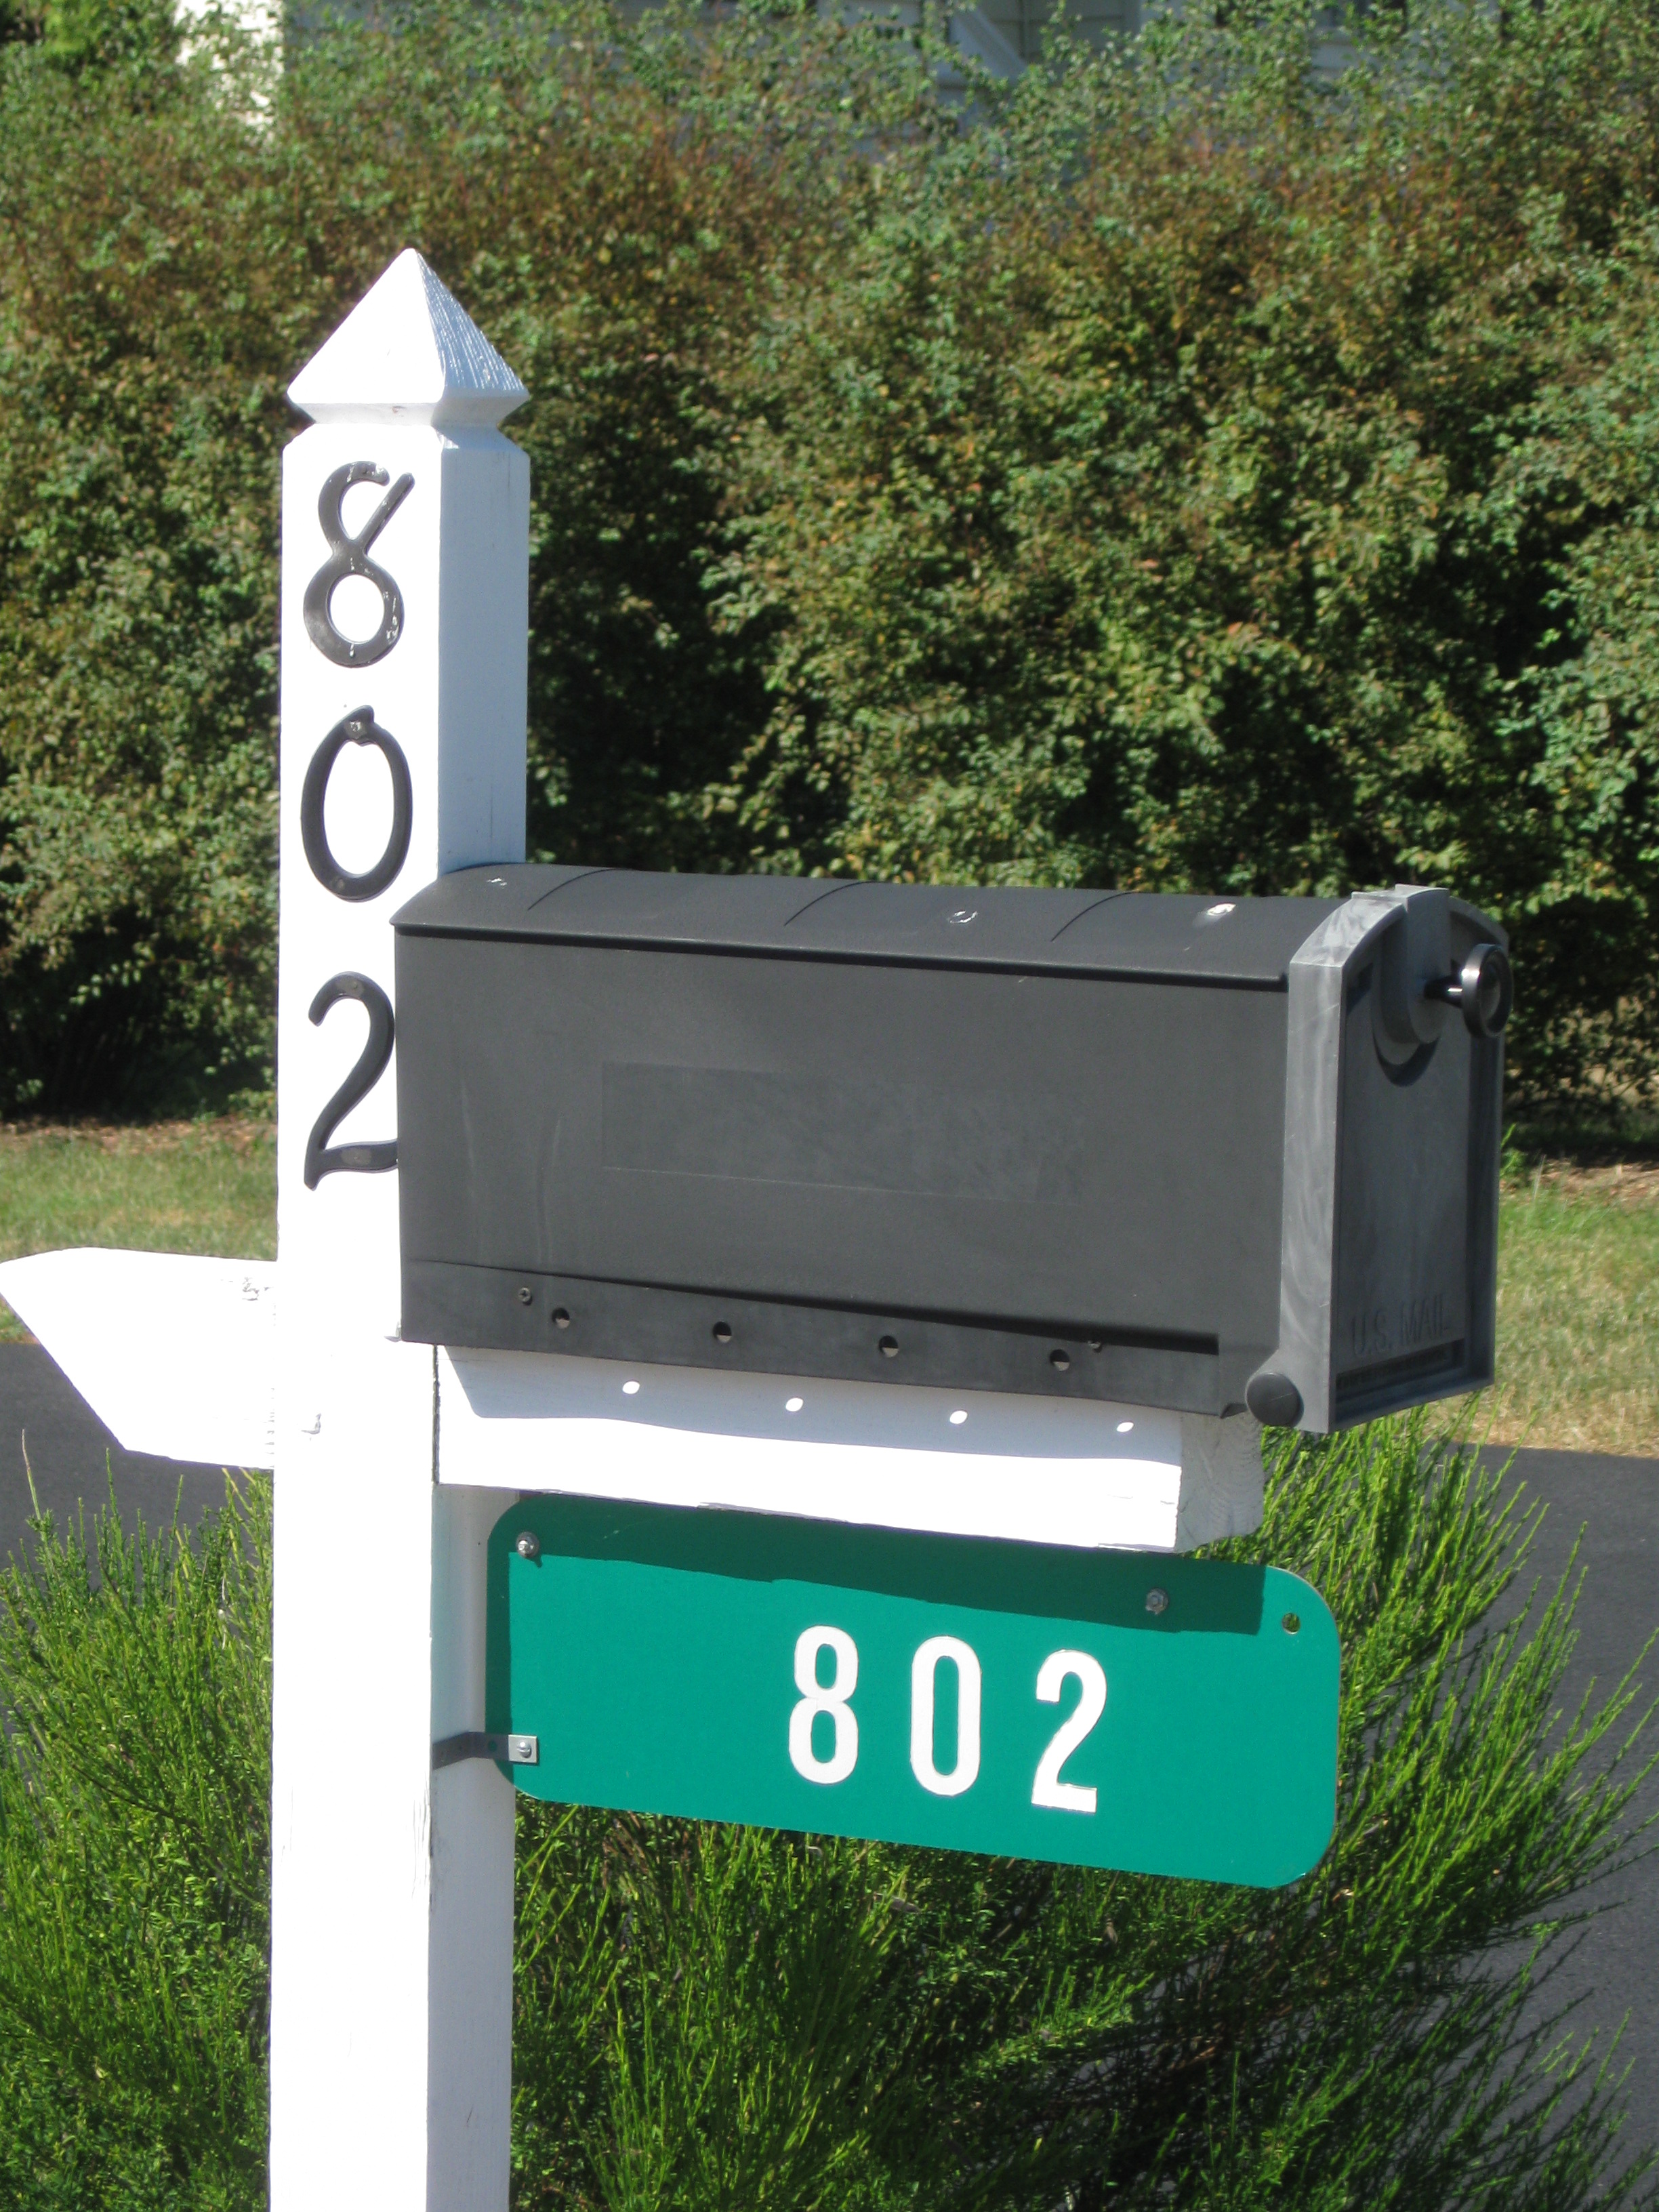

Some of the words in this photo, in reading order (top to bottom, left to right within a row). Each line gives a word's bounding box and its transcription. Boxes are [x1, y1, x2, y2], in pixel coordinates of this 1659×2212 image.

[301, 460, 415, 1190] 802
[1350, 1307, 1392, 1357] U.S.
[1400, 1294, 1450, 1346] MAIL
[789, 1624, 1107, 1813] 802
